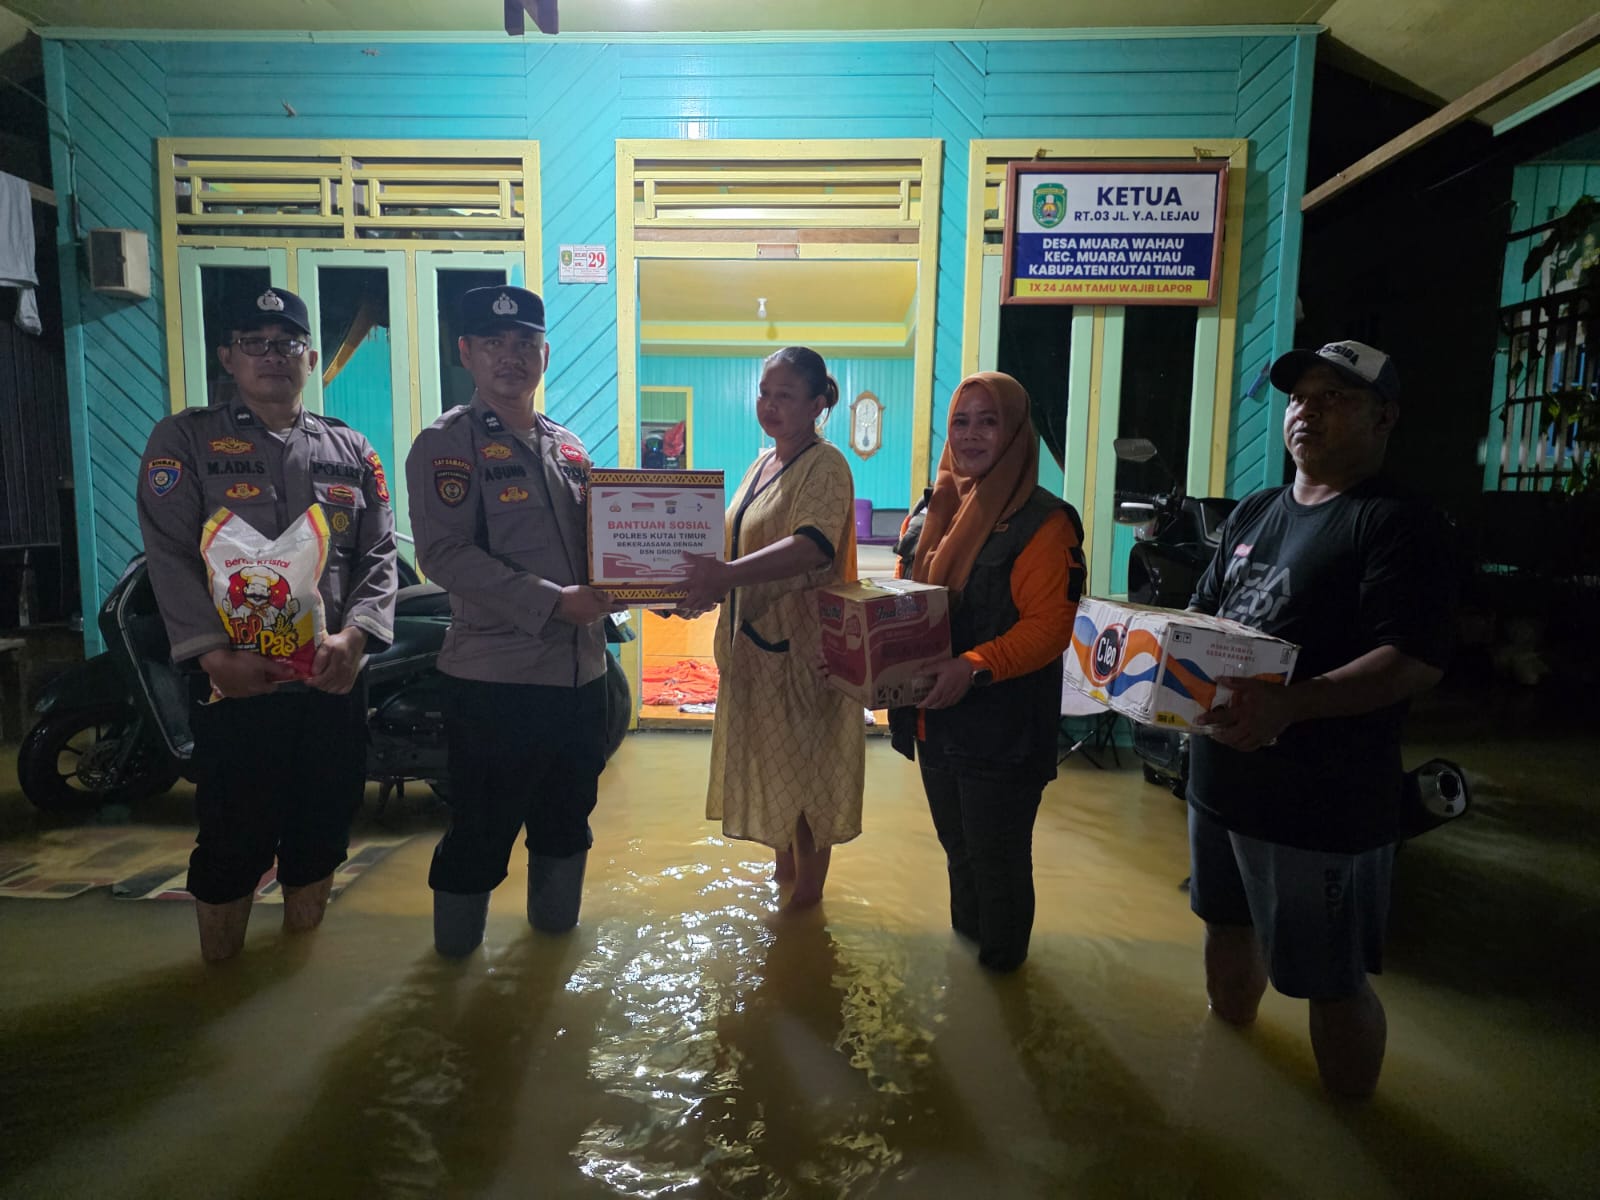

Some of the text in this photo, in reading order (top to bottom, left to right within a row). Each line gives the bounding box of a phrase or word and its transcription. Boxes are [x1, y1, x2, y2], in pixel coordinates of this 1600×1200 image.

[1097, 187, 1182, 206] KETUA
[1074, 211, 1199, 221] RT.03 JL. Y.A. LEJAU
[1042, 238, 1185, 249] DESA MUARA WAHAU
[588, 252, 605, 268] 29
[1044, 251, 1181, 263] KEC. MUARA WAHAU
[1029, 264, 1195, 276] KABUPATEN KUTAI TIMUR
[1029, 283, 1192, 293] 1X 24 JAM TAMU WAJIB LAPOR
[608, 521, 711, 530] BANTUAN SOSIAL
[1096, 636, 1117, 667] Cleo
